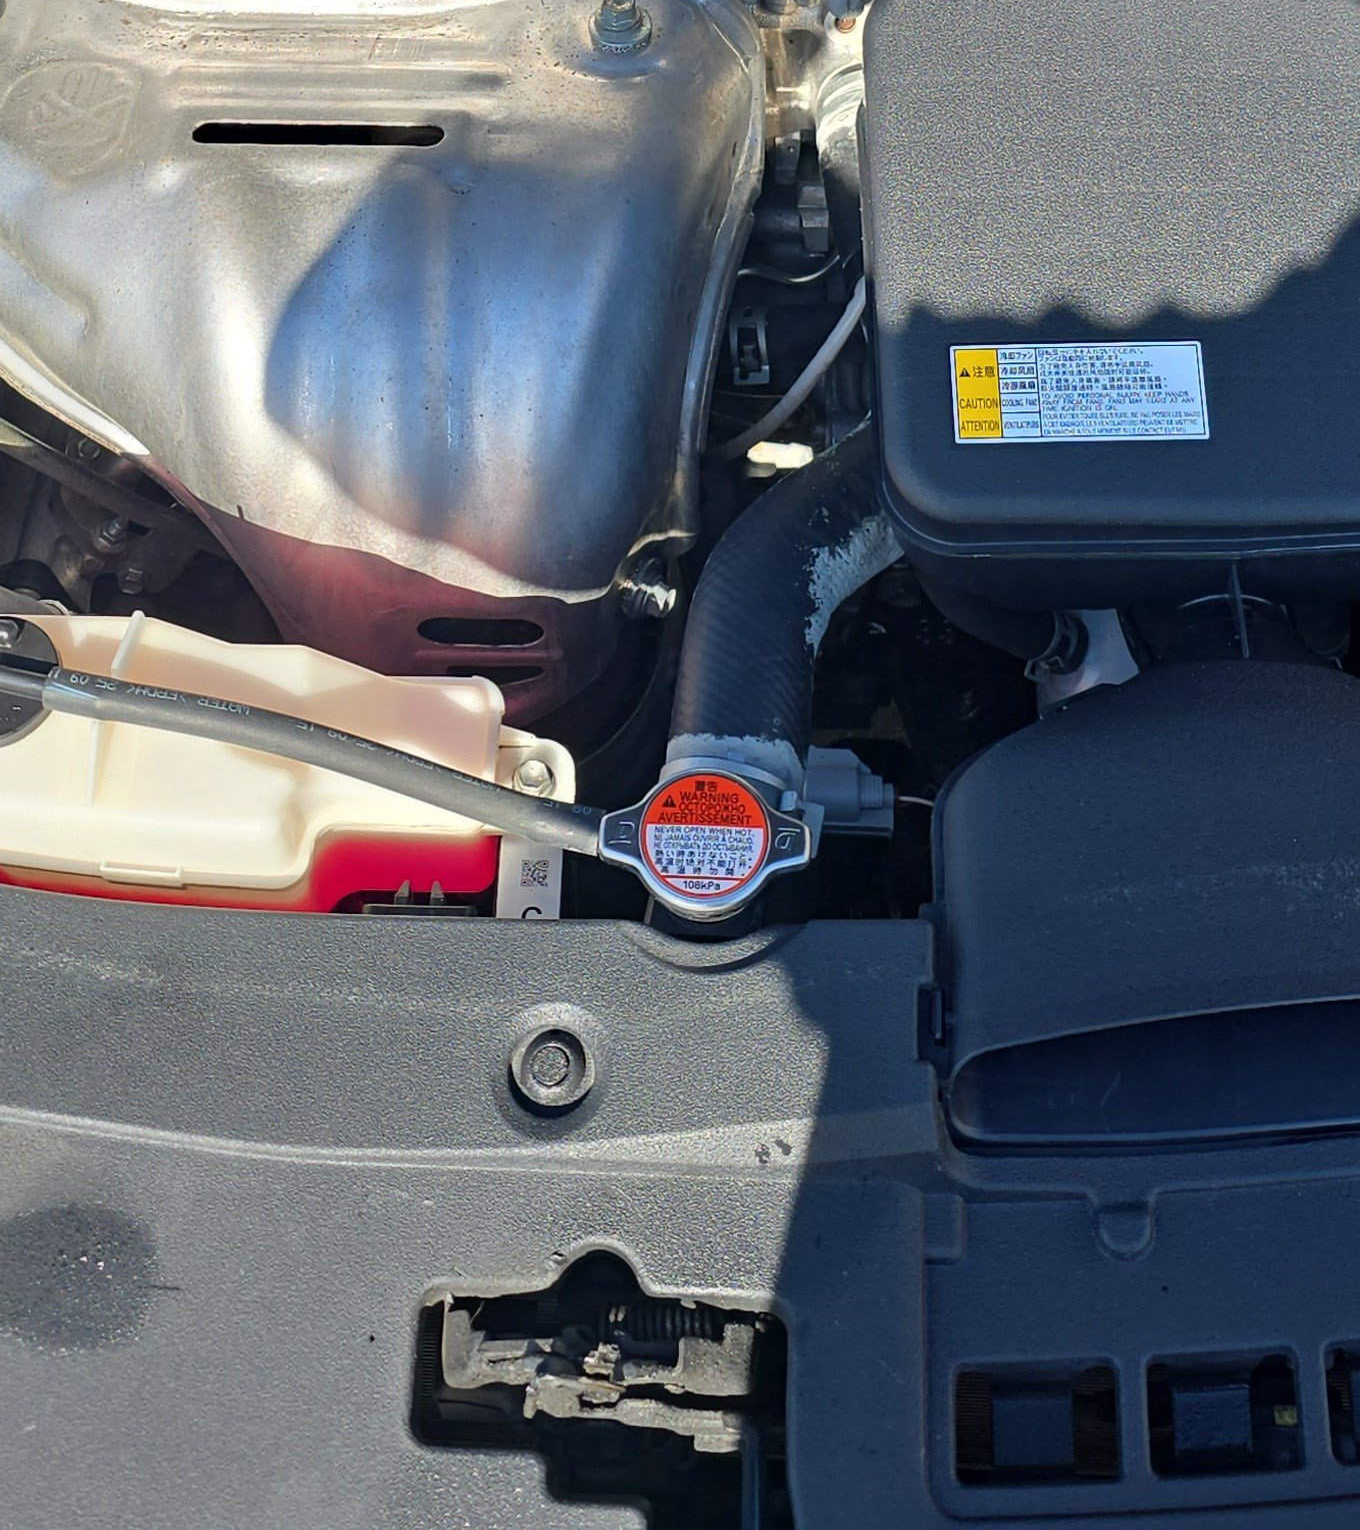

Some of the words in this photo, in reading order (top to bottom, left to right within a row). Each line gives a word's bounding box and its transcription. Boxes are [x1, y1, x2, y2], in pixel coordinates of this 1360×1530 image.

[973, 366, 995, 378] 注意
[960, 398, 998, 409] CAUTION
[961, 420, 1000, 432] ATTENTION
[196, 696, 252, 716] WATER
[695, 781, 718, 792] 警告
[680, 791, 740, 804] WARNING
[679, 802, 746, 815] ОСТОРОЖНО
[658, 812, 752, 825] AVERTISSEMENT
[654, 826, 682, 834] NEVER
[708, 827, 733, 836] WHEN
[683, 880, 721, 890] 108kPa
